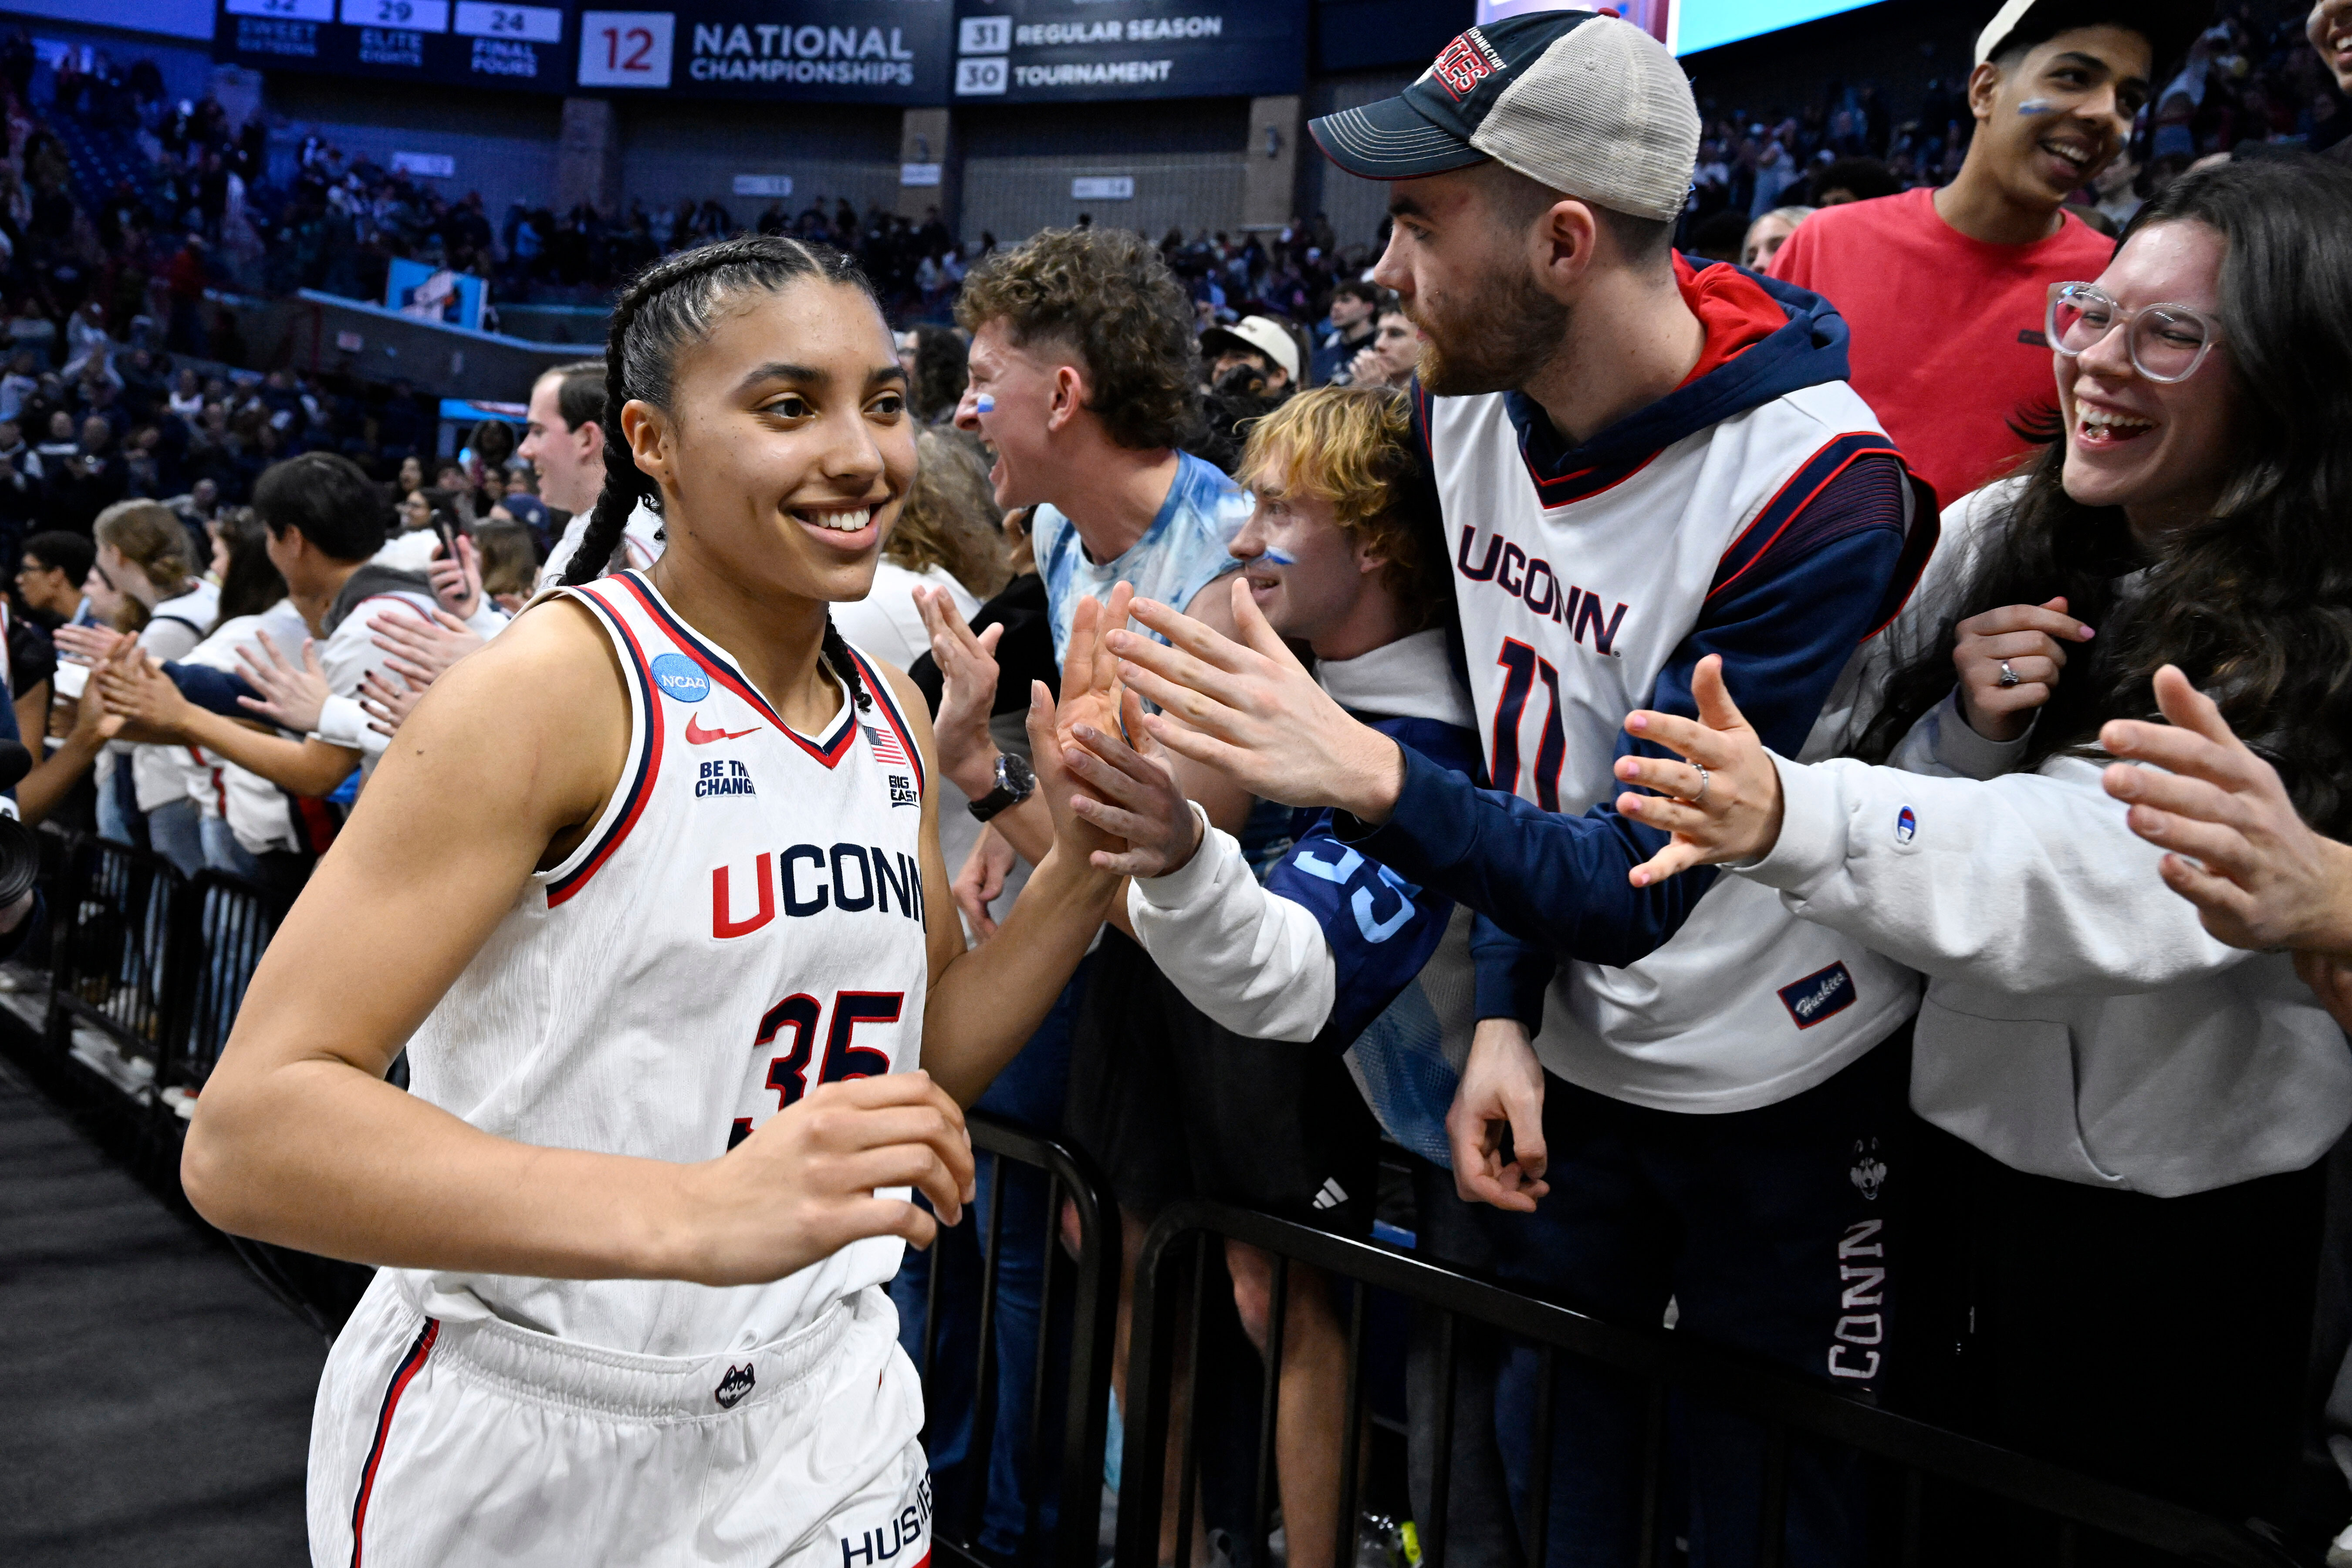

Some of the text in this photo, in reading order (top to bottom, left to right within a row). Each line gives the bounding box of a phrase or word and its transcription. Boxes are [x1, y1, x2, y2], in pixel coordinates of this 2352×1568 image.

[490, 10, 522, 31] 24
[1016, 16, 1221, 44] REGULAR SEASON
[602, 27, 653, 71] 12
[693, 23, 913, 60] NATIONAL
[689, 58, 913, 85] CHAMPIONSHIPS
[966, 65, 999, 86] 30
[1015, 61, 1172, 86] TOURNAMENT
[1458, 525, 1629, 656] UCONN
[662, 675, 707, 689] NCAA
[1491, 636, 1566, 813] 11
[700, 760, 750, 779] BE TH
[889, 775, 909, 789] BIG
[891, 788, 917, 802] EAST
[713, 843, 926, 939] UCONN
[727, 990, 904, 1155] 35
